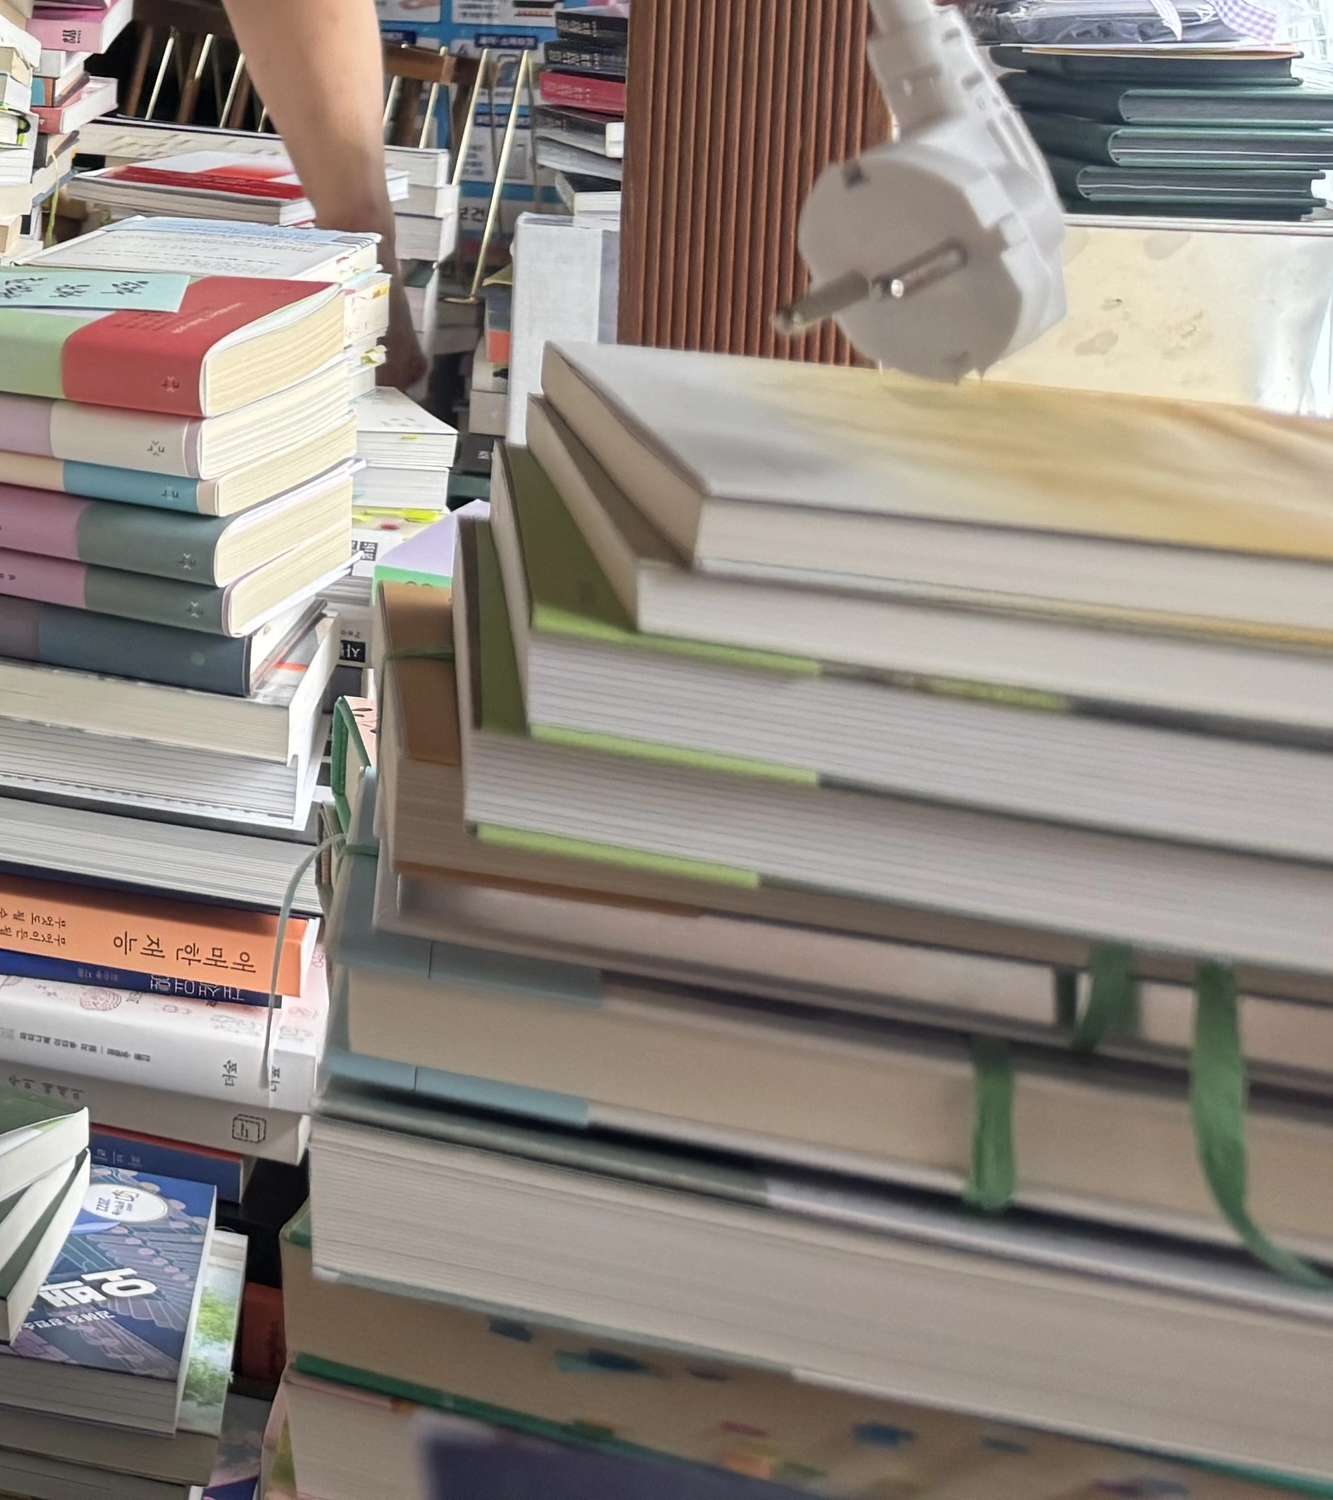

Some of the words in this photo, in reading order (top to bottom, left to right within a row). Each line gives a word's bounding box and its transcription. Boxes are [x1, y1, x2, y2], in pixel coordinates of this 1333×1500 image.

[13, 909, 26, 922] 될
[30, 911, 67, 929] 무엇도
[0, 924, 13, 938] 될
[16, 927, 66, 946] 무엇이든
[112, 930, 167, 960] 재능
[176, 942, 257, 975] 애매한
[222, 1059, 239, 1087] 더숲
[37, 1267, 158, 1309] 오백
[21, 1316, 64, 1332] 장편소
